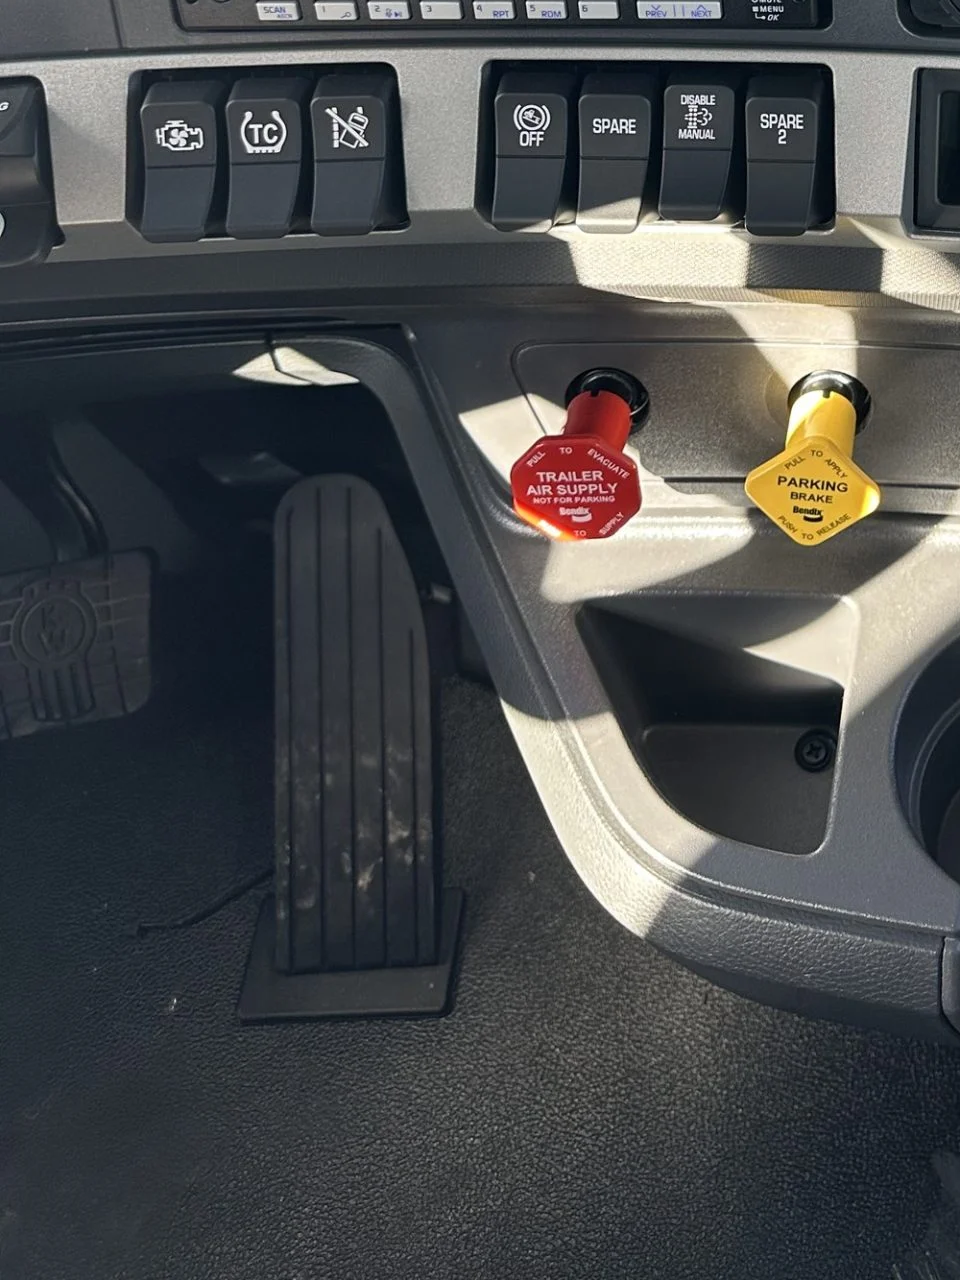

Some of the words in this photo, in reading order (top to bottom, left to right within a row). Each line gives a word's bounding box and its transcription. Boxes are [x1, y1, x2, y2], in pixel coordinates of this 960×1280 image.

[263, 6, 286, 14] SCAN
[426, 5, 432, 13] 3
[476, 4, 483, 12] 4
[492, 10, 510, 18] RPT
[529, 4, 536, 12] 5
[541, 10, 562, 18] RDM
[645, 10, 667, 18] PREV
[691, 10, 713, 18] NEXT
[680, 94, 716, 106] DISABLE
[592, 118, 637, 135] SPARE
[760, 114, 804, 130] SPARE
[250, 122, 278, 143] TC
[678, 128, 716, 141] MANUAL
[777, 130, 787, 145] 2
[519, 132, 544, 147] OFF
[526, 450, 546, 468] PULL
[560, 447, 573, 455] TO
[587, 448, 630, 480] EVACUATE
[784, 456, 806, 470] PULL
[810, 449, 824, 458] TO
[824, 458, 848, 479] APPLY
[536, 470, 604, 482] TRAILER
[526, 484, 553, 496] AIR
[556, 483, 618, 495] SUPPLY
[777, 475, 848, 493] PARKING
[533, 497, 551, 505] NOT
[575, 496, 616, 504] PARKING
[790, 491, 833, 504] BRAKE
[559, 507, 591, 516] Bendix
[792, 506, 823, 517] Bendix
[598, 512, 625, 535] SUPPLY
[778, 515, 798, 534] PUSH
[802, 532, 814, 540] TO
[816, 513, 852, 537] RELEASE
